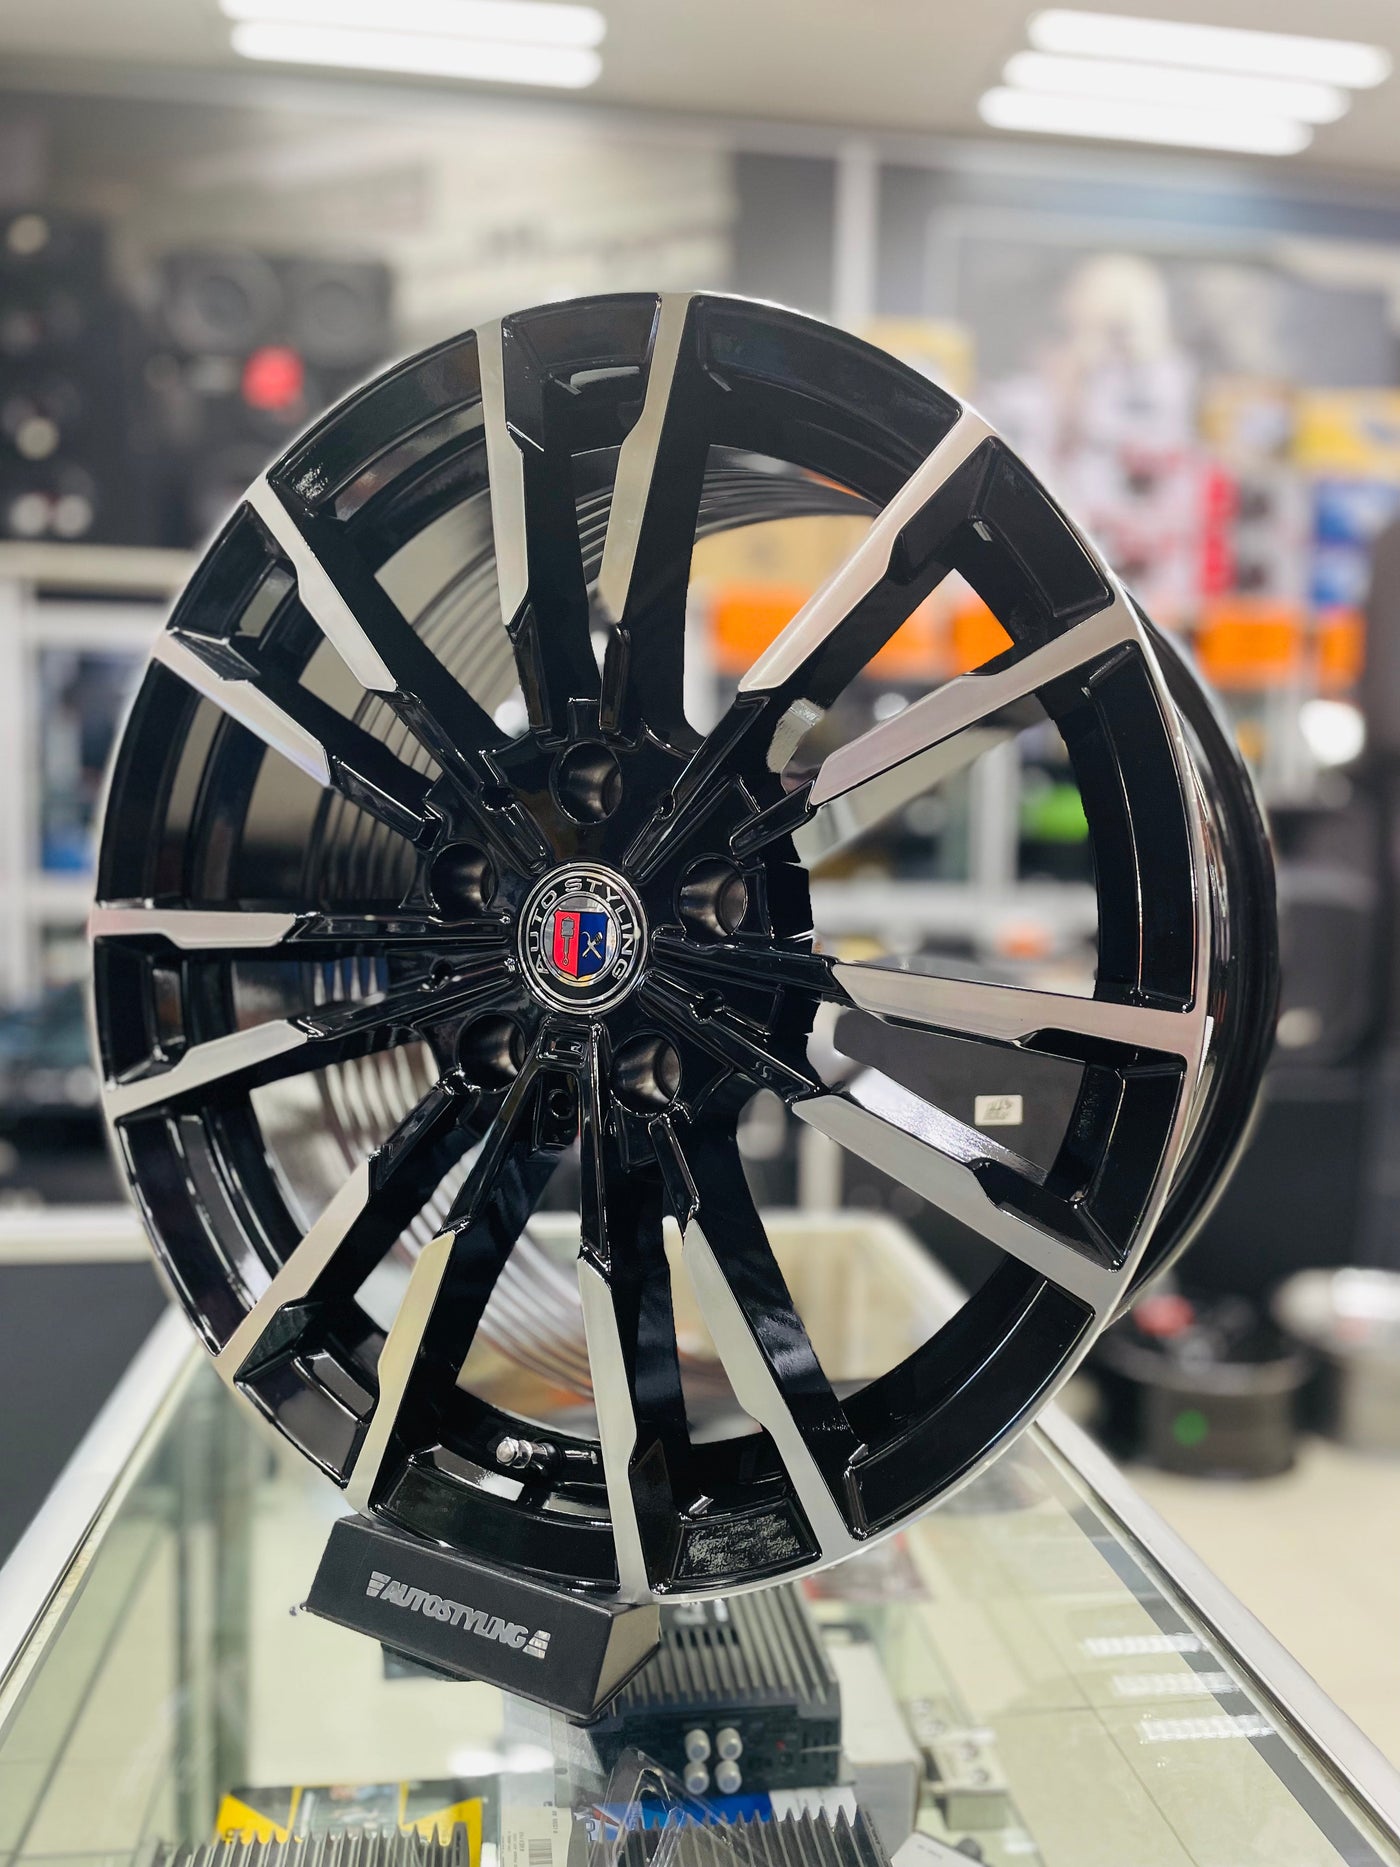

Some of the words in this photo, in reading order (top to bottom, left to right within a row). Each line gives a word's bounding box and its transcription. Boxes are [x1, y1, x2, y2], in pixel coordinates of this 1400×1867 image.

[529, 889, 558, 975] AUTO
[564, 878, 634, 980] STYLING
[380, 1580, 529, 1649] AUTOSTYLING
